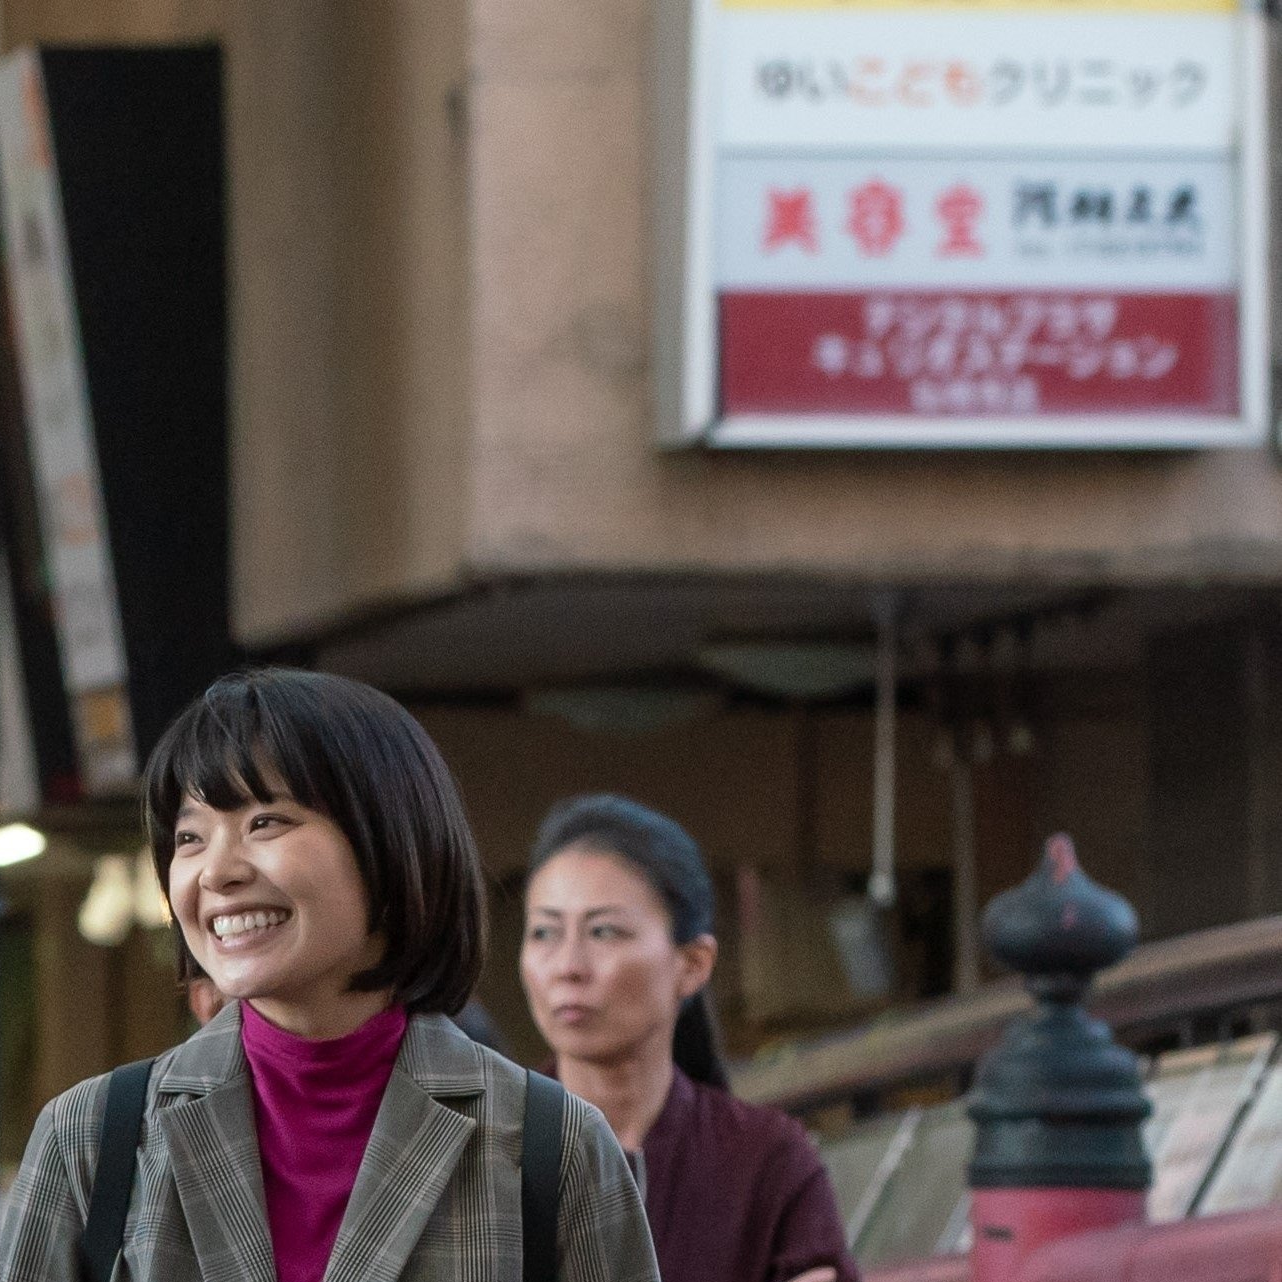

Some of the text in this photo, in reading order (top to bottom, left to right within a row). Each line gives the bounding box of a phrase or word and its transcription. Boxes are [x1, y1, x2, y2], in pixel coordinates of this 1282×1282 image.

[755, 57, 1208, 106] ゆいこどもクリニック
